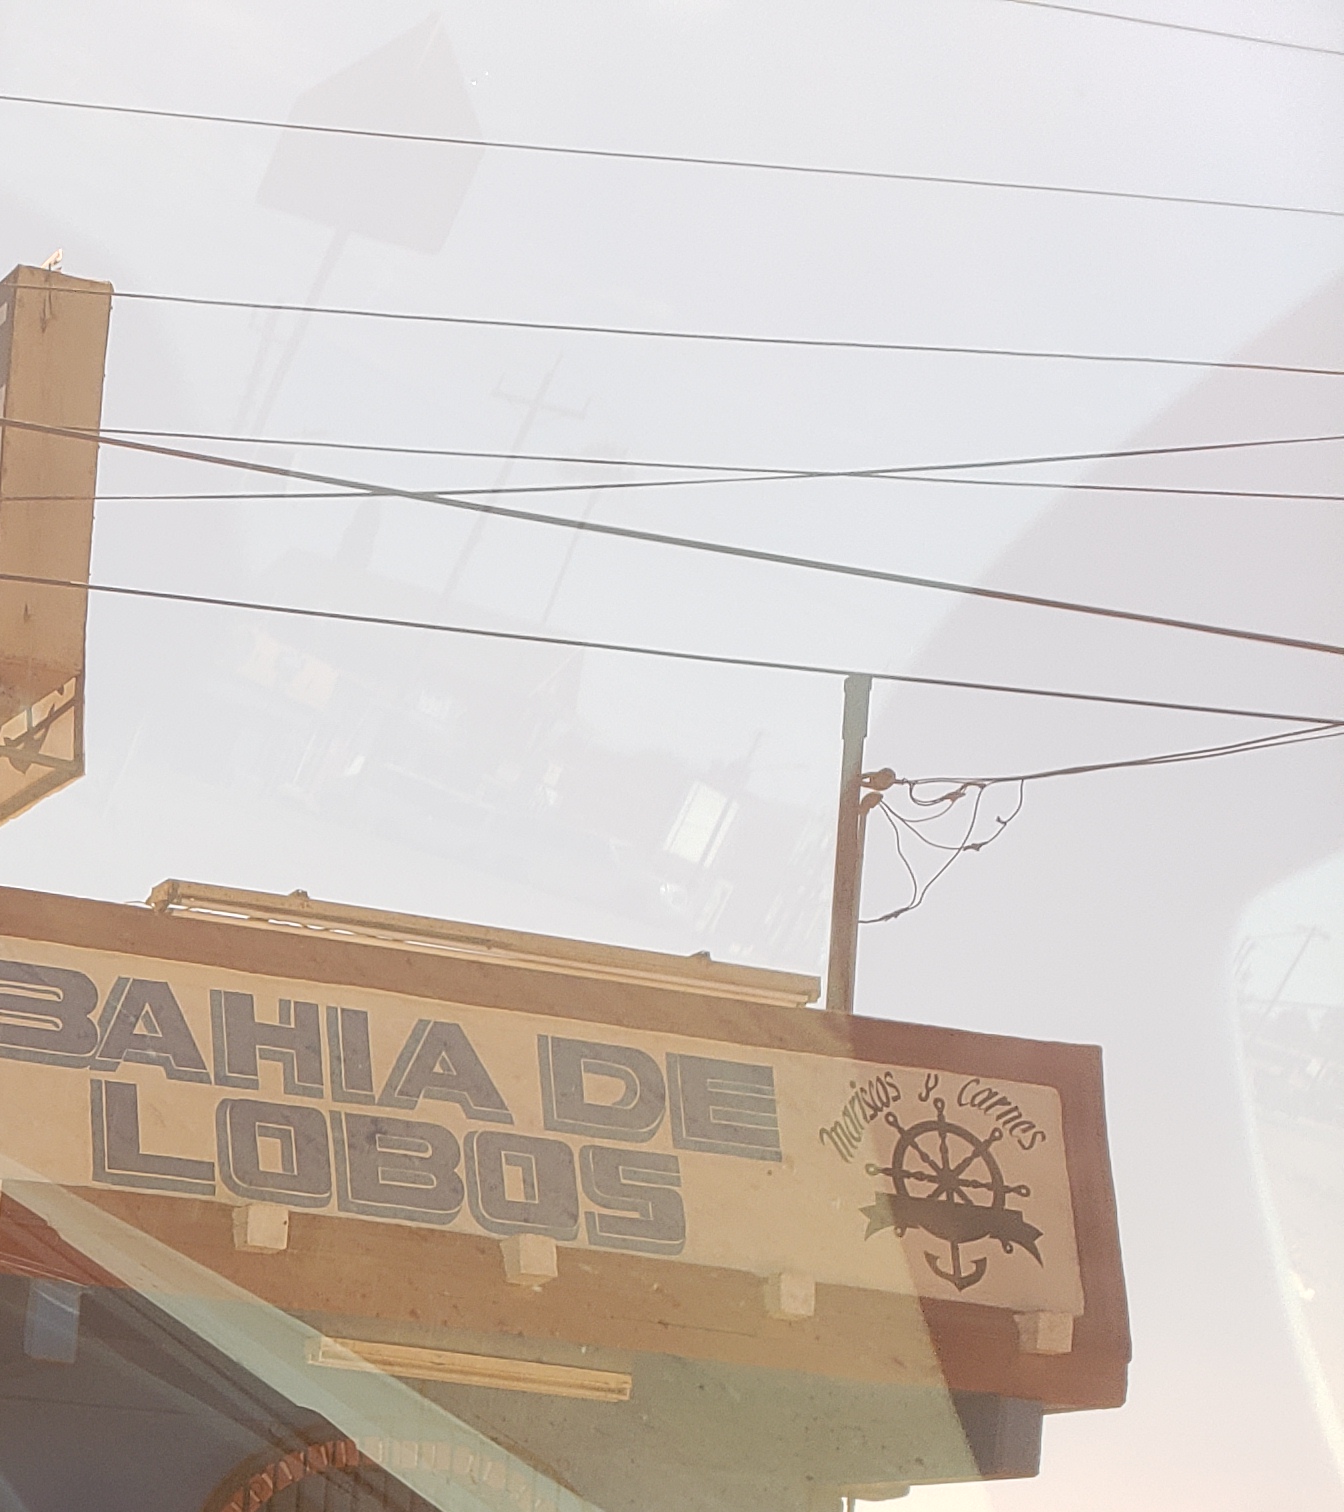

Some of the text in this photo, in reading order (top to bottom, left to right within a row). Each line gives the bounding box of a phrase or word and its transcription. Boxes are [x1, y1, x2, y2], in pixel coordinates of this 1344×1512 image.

[537, 1033, 783, 1162] DE
[957, 1078, 1046, 1150] Carnes
[89, 1079, 686, 1253] LOBOS
